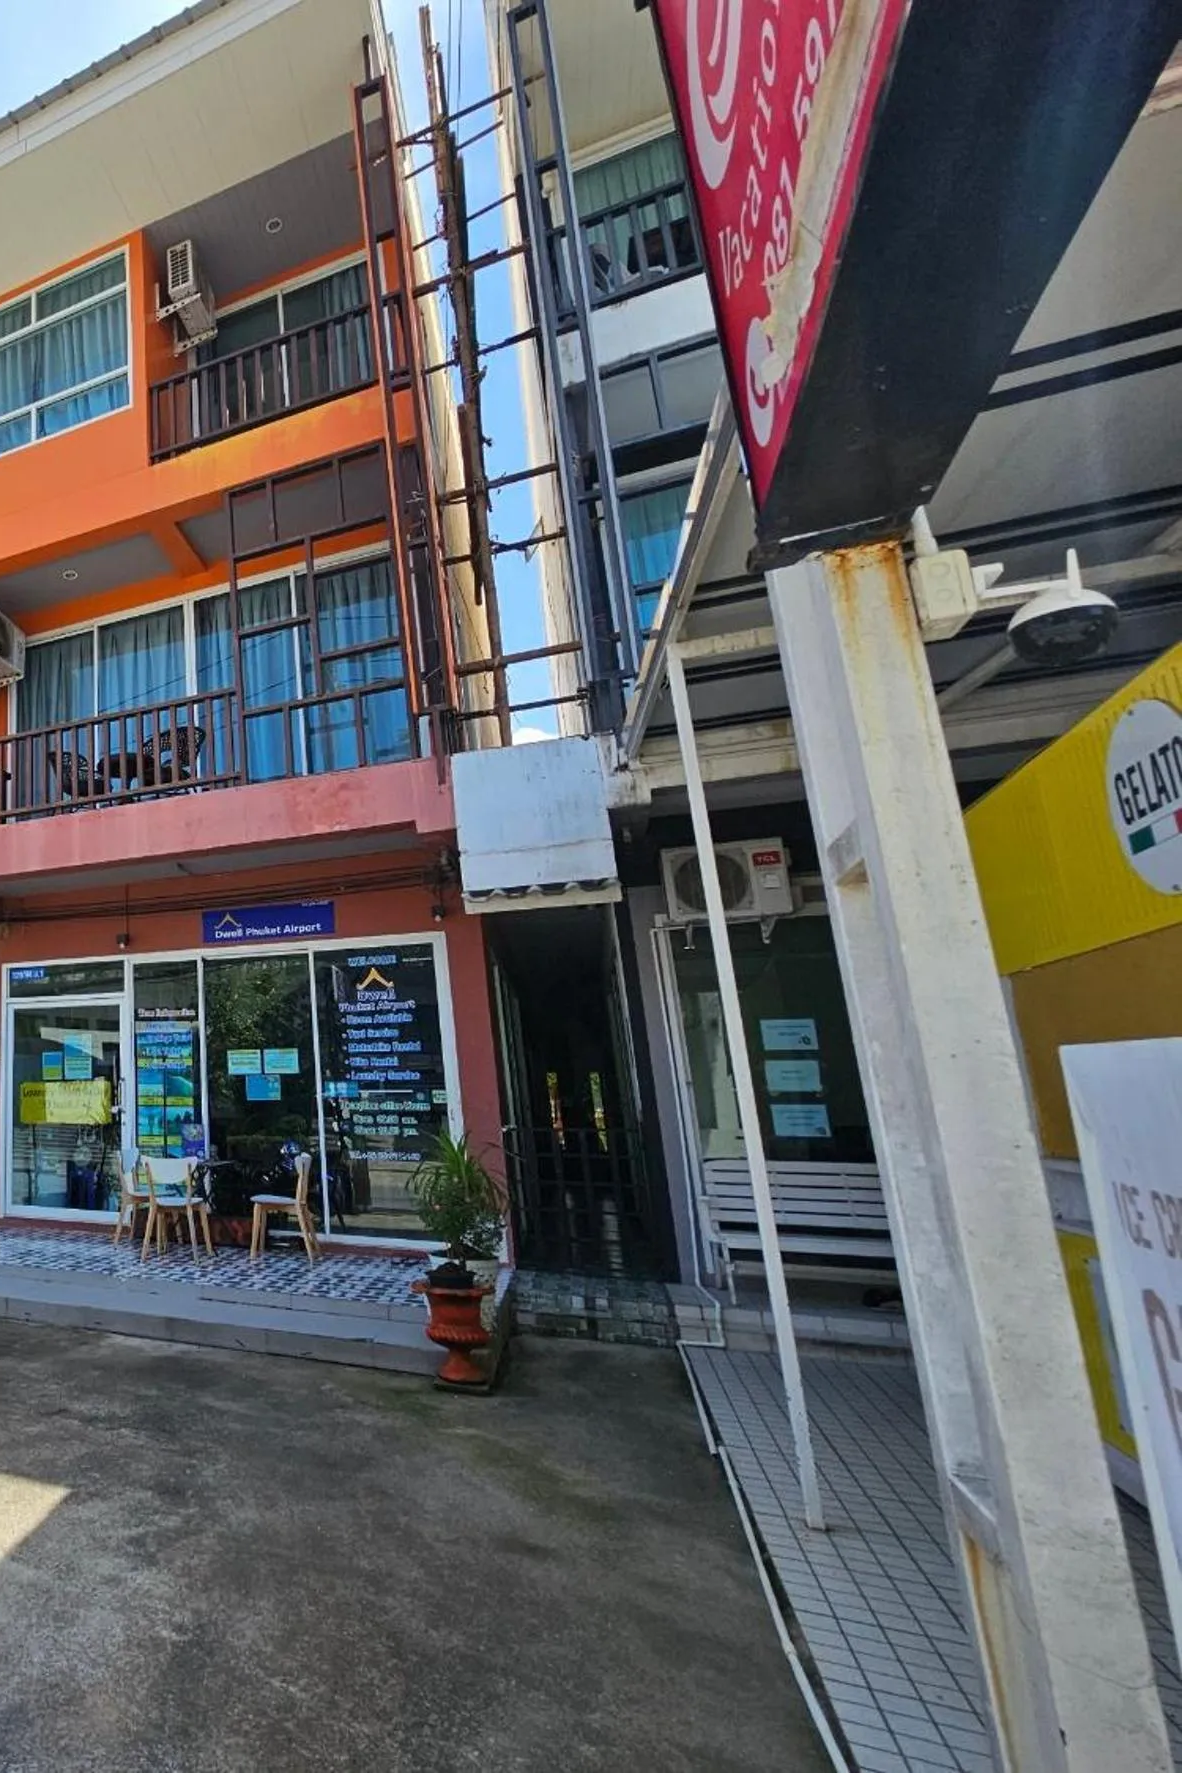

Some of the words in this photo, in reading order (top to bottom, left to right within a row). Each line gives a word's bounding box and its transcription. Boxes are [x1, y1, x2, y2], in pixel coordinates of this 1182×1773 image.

[215, 928, 243, 939] Dwell
[245, 926, 280, 936] Phuket
[283, 922, 321, 934] Airport
